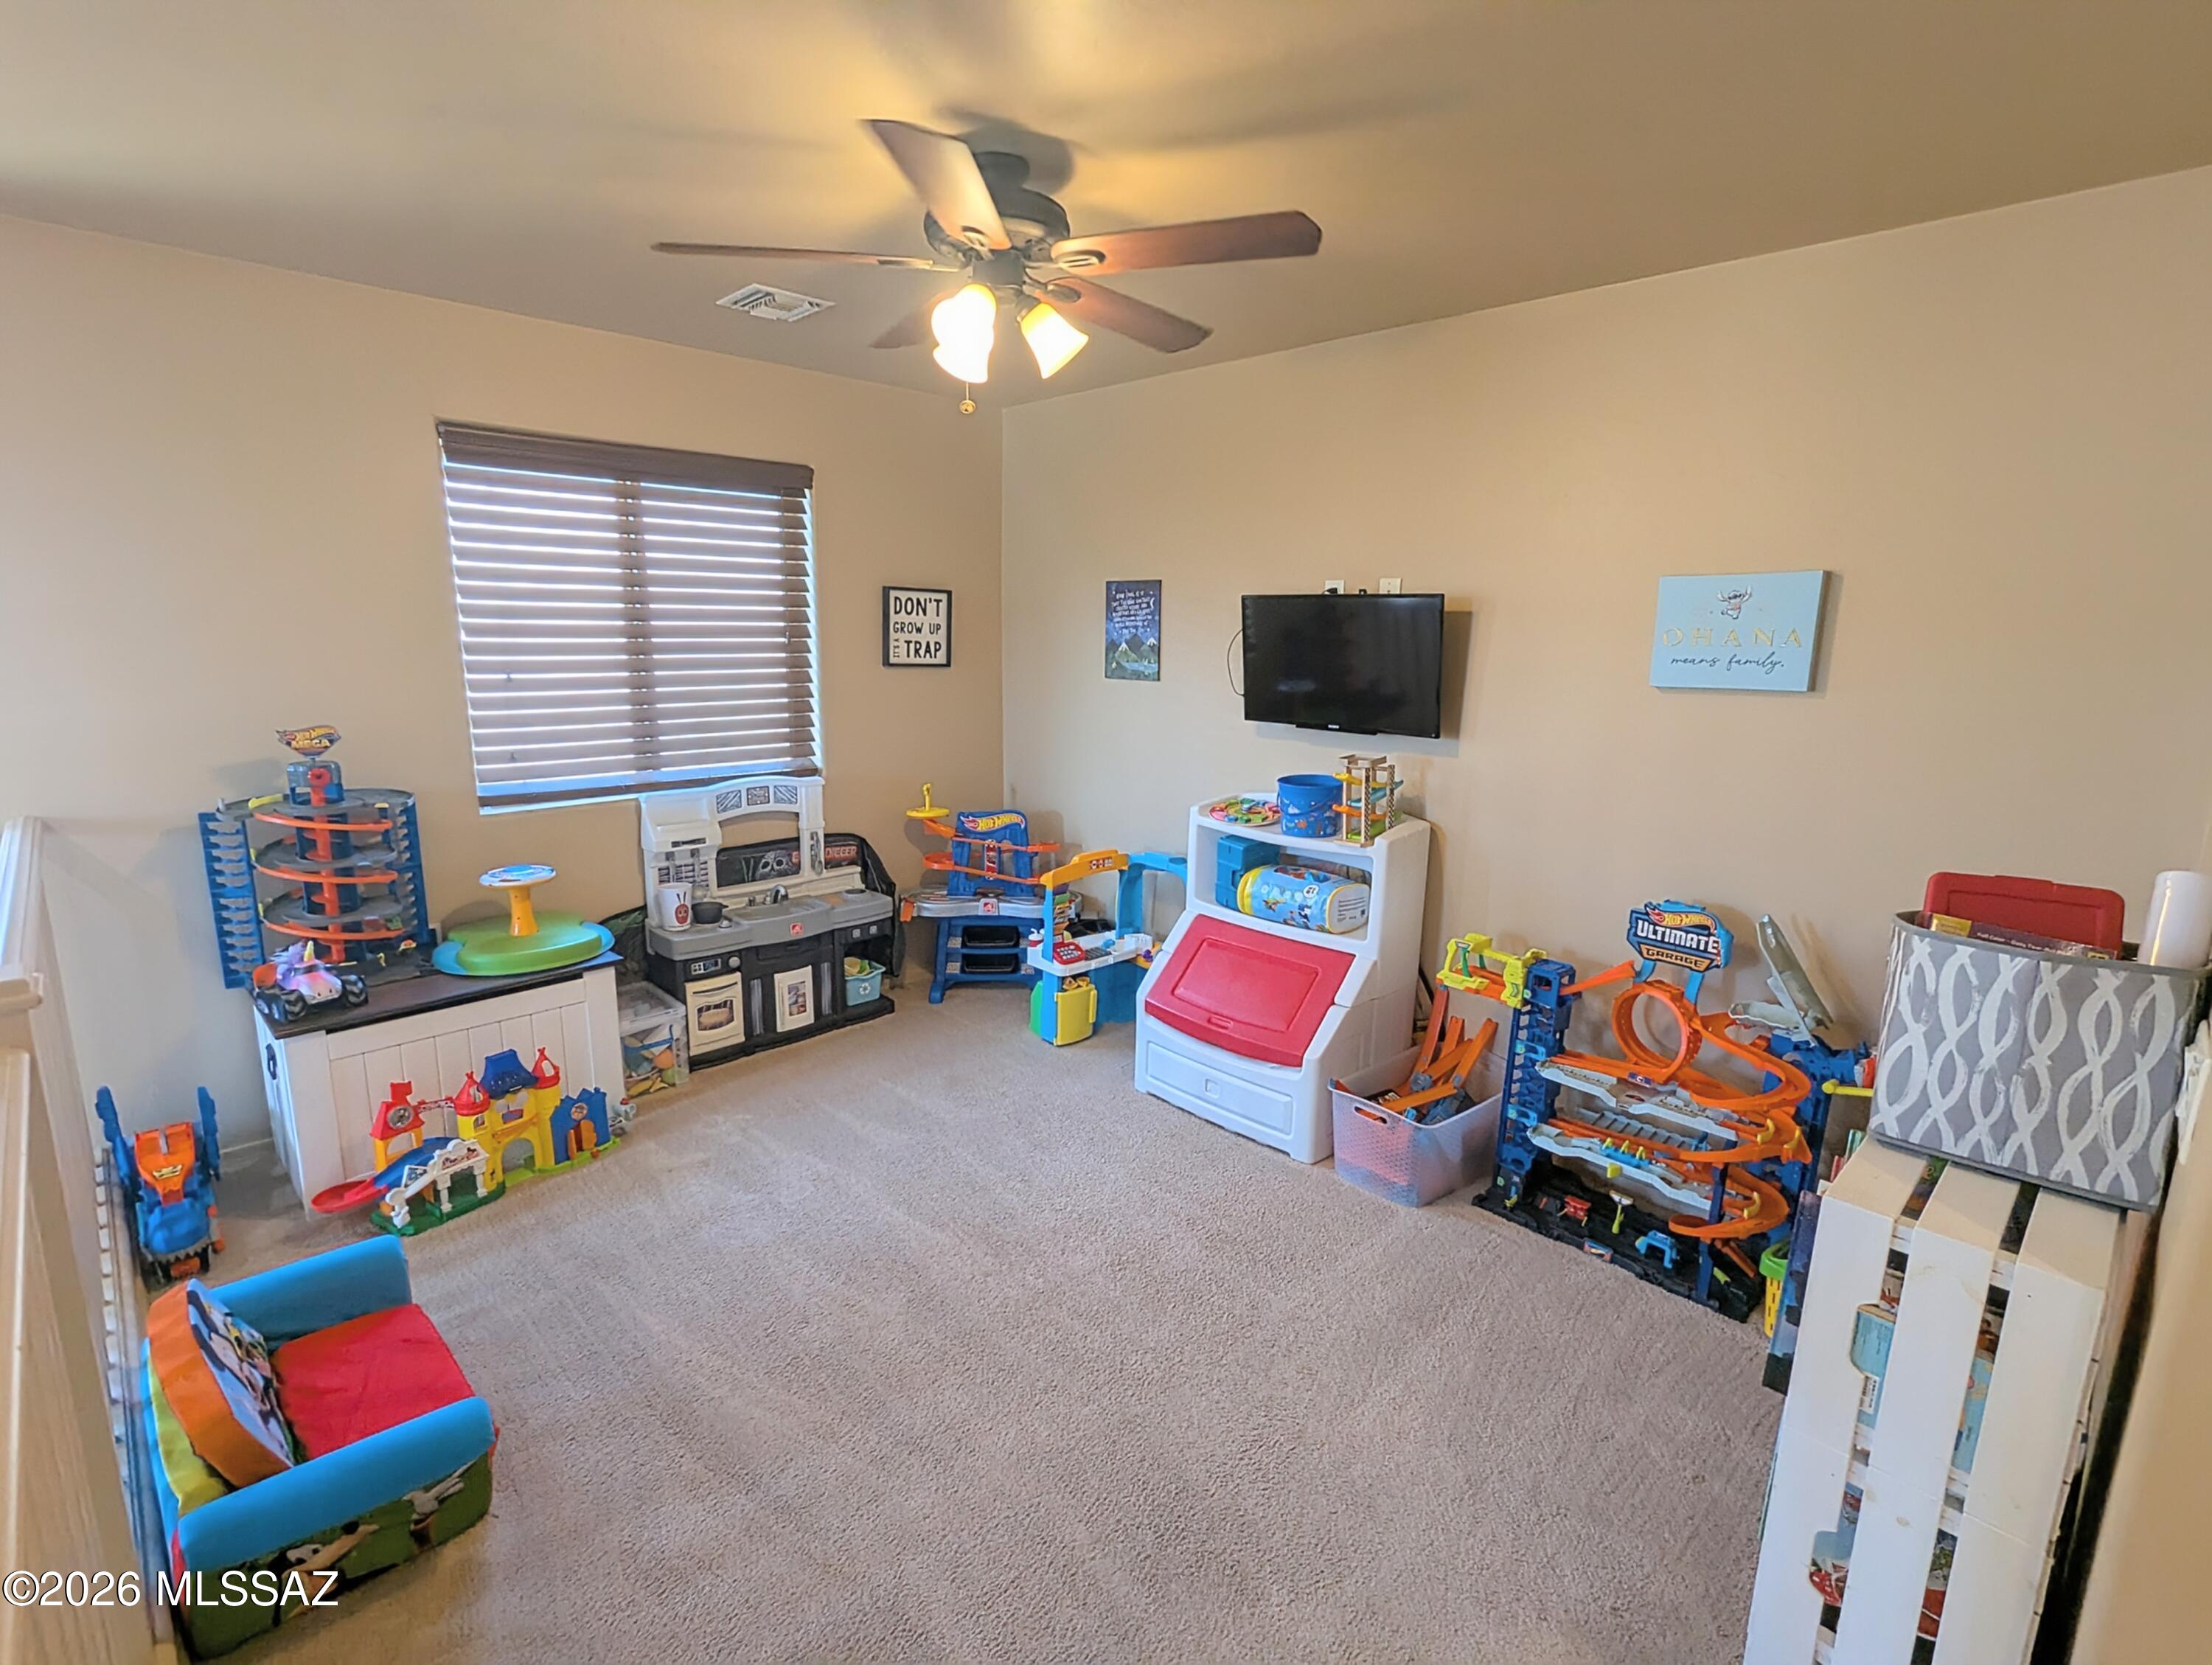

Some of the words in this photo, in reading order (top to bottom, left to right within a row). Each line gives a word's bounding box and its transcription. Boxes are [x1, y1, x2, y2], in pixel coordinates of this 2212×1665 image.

[894, 596, 943, 617] DON'T
[893, 622, 923, 634] GROW
[929, 623, 942, 635] UP
[1663, 628, 1801, 647] OHANA
[904, 640, 942, 658] TRAP
[1670, 657, 1720, 667] means
[1726, 651, 1784, 675] family.
[291, 740, 330, 750] MEGA
[978, 817, 996, 832] HOT
[1664, 913, 1683, 927] HOT
[1637, 920, 1720, 953] ULTIMATE
[1645, 948, 1705, 968] GARAGE
